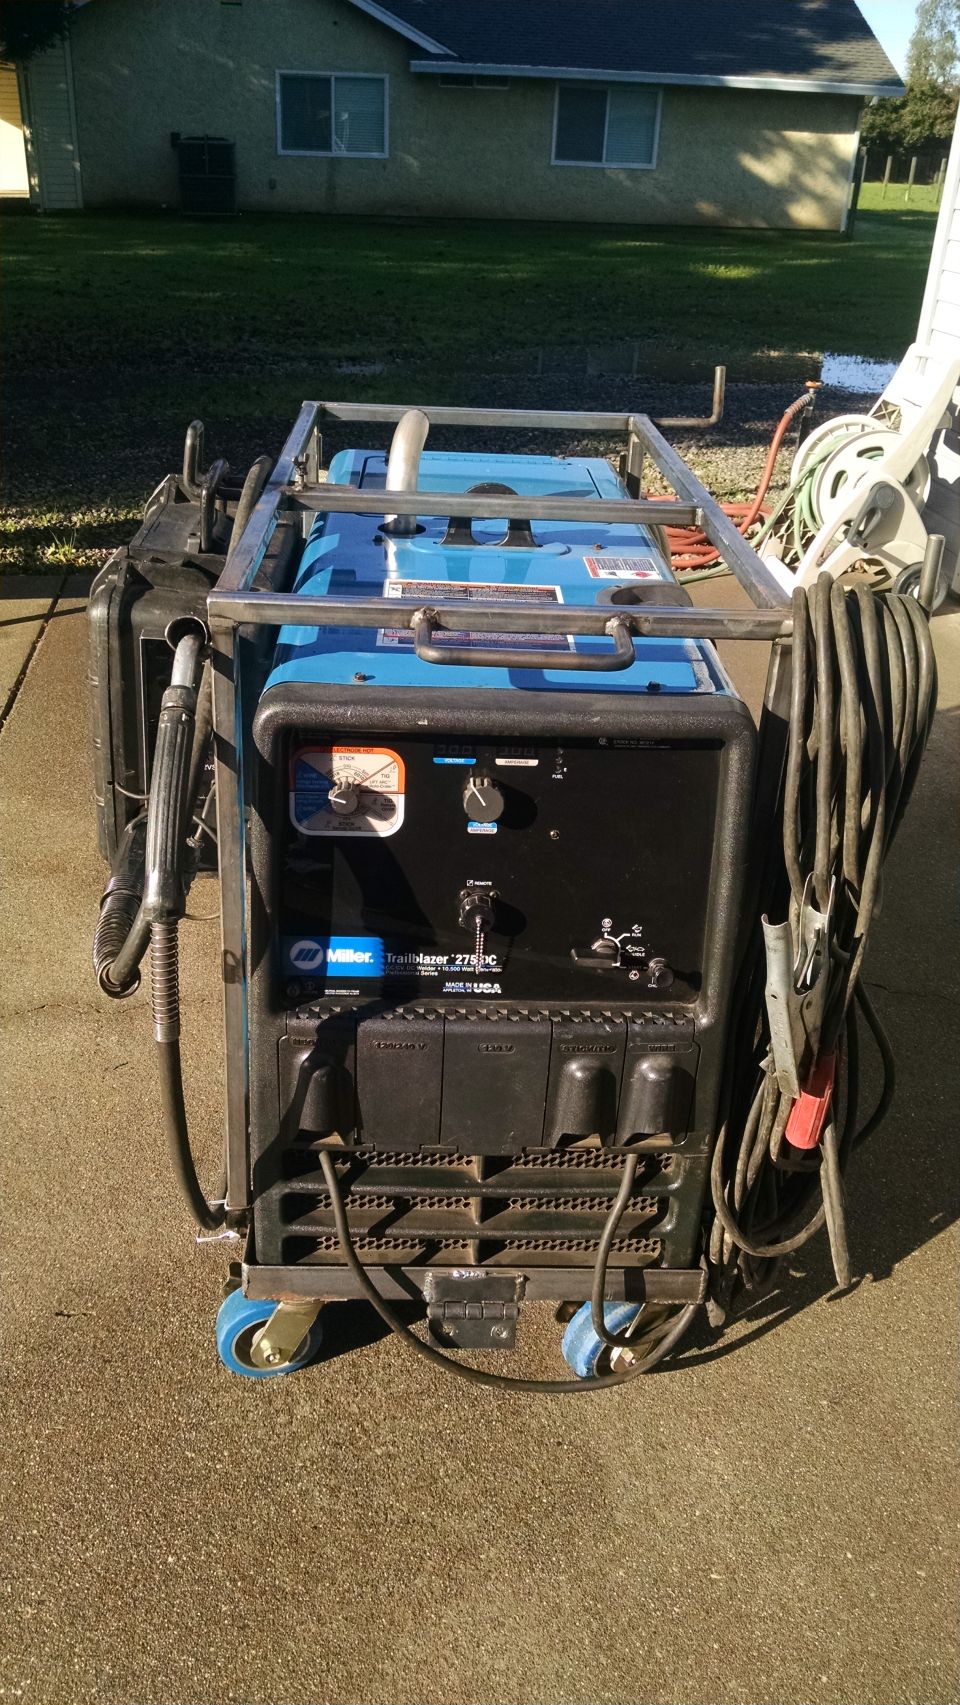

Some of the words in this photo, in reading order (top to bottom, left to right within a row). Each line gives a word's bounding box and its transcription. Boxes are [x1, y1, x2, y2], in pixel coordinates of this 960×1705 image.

[386, 953, 448, 964] Trailblazer
[455, 954, 477, 964] 275
[474, 983, 502, 993] USA
